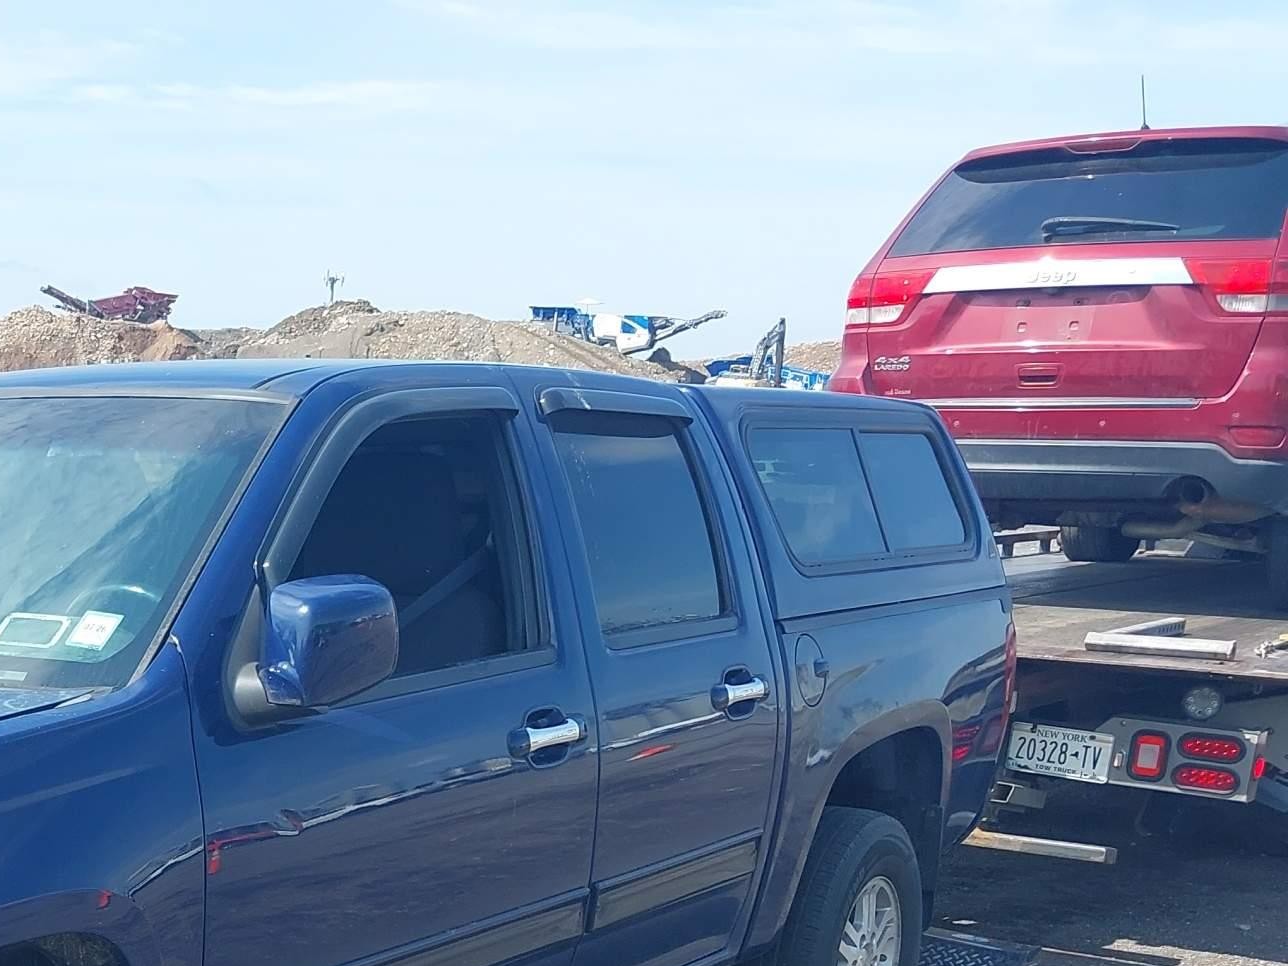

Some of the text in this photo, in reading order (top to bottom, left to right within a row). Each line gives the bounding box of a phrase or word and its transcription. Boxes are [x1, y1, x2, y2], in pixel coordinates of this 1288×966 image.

[1025, 271, 1078, 285] Jeep
[1036, 729, 1088, 743] NEW YORK
[1035, 764, 1077, 775] TOW TRUCK
